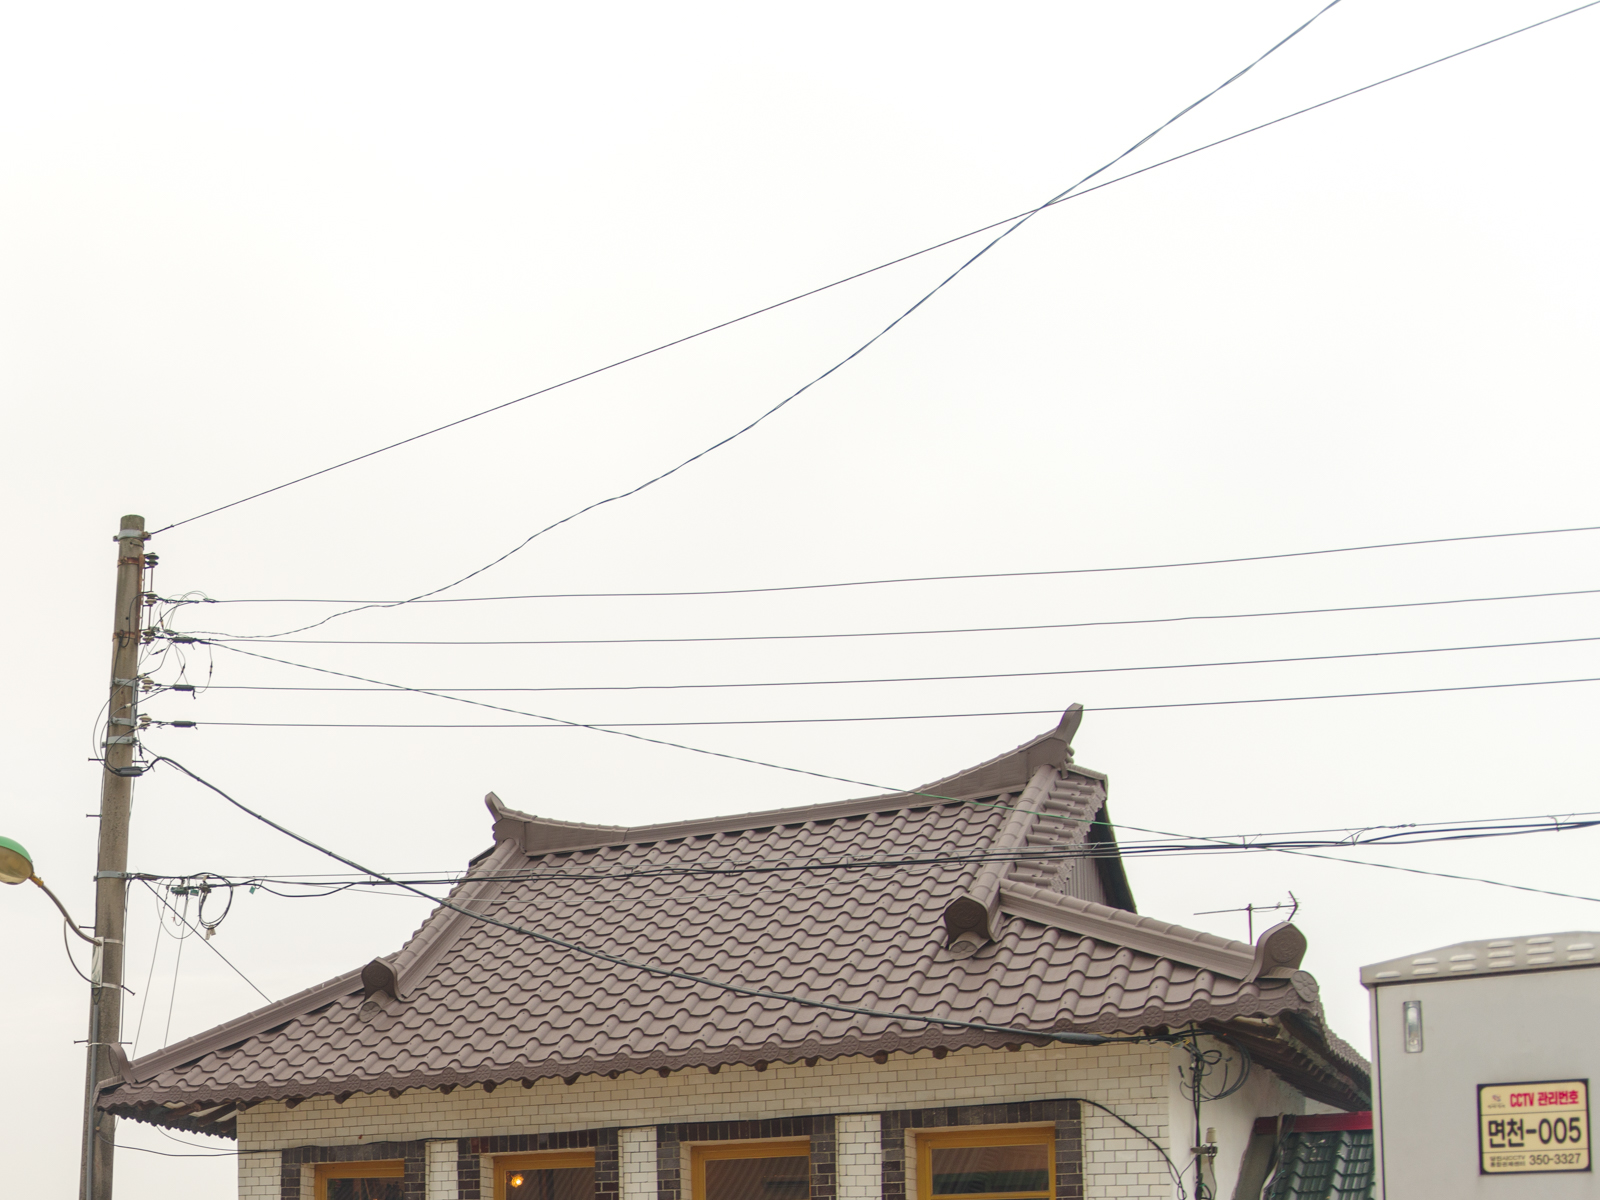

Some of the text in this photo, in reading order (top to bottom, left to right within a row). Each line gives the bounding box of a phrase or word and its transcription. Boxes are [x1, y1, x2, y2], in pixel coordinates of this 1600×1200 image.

[1510, 1090, 1579, 1107] CCTV 관리번호
[1488, 1117, 1582, 1148] 면천-005
[1529, 1153, 1581, 1166] 350-3327
